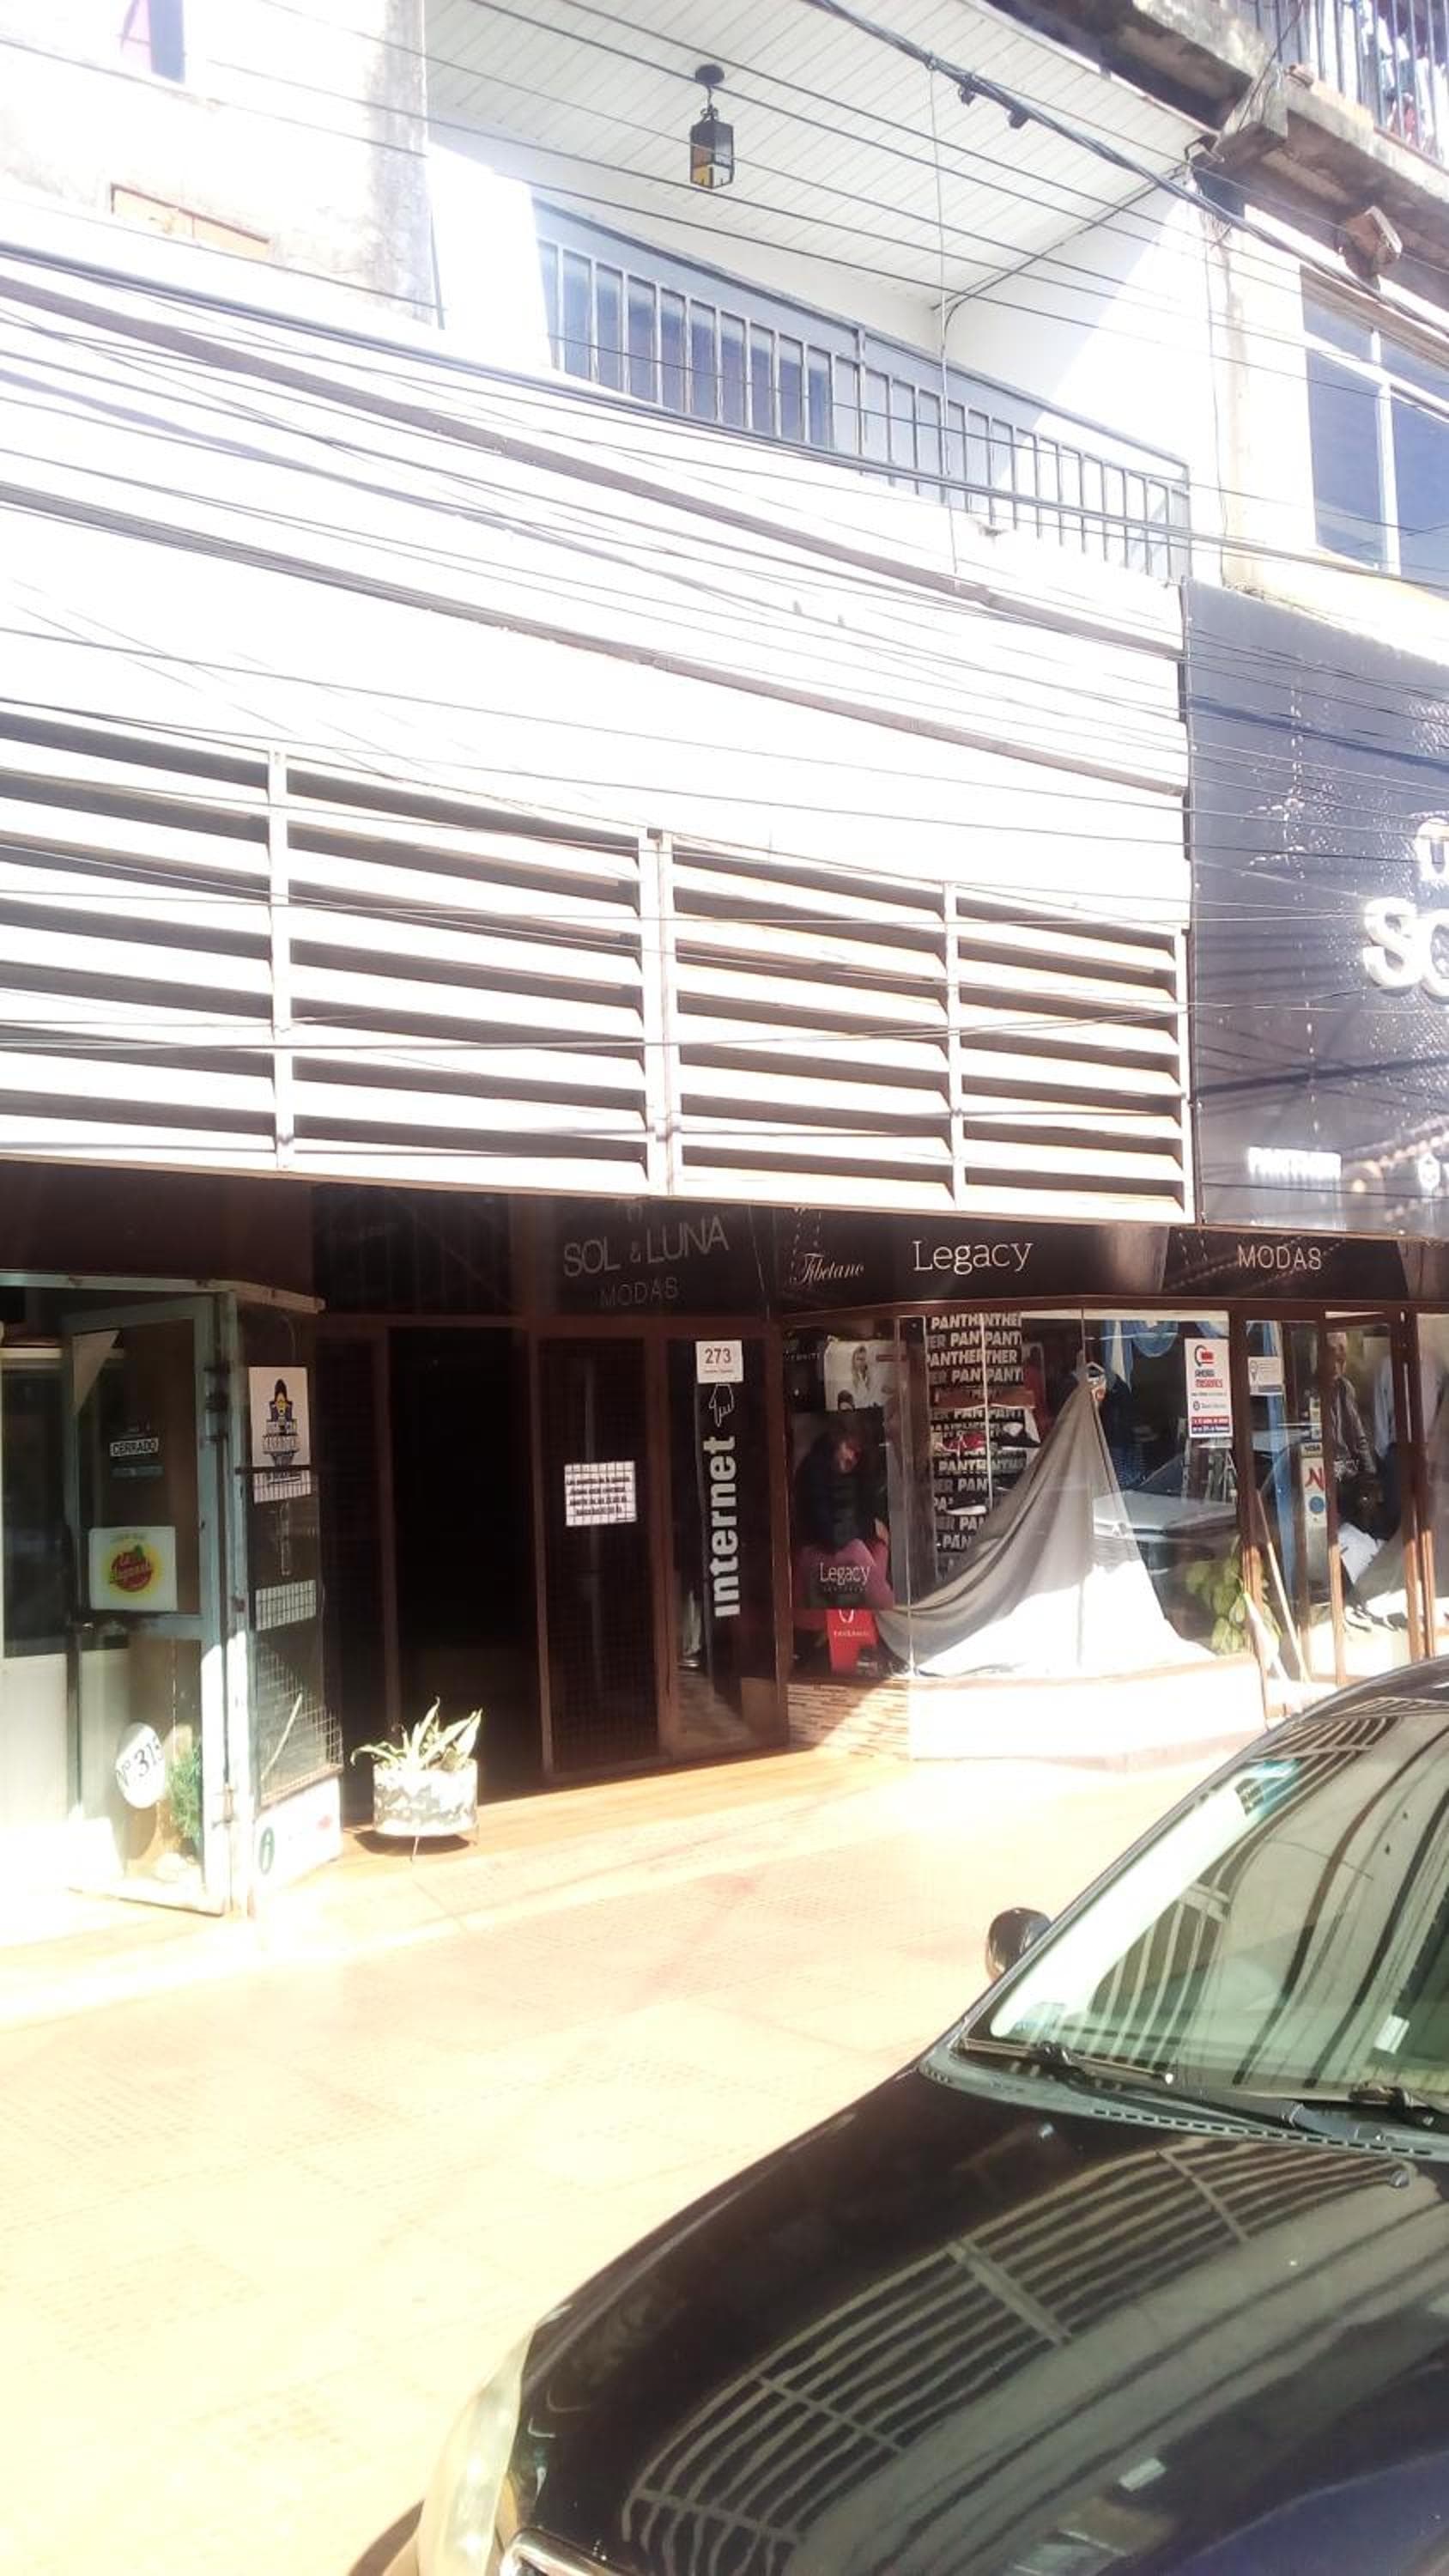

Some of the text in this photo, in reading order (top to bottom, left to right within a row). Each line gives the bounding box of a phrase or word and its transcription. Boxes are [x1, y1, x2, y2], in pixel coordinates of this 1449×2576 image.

[563, 1236, 621, 1277] SOL
[647, 1215, 730, 1264] LUNA
[912, 1240, 1034, 1275] Legacy
[1238, 1245, 1322, 1270] MODAS
[603, 1277, 680, 1305] MODAS
[705, 1347, 731, 1364] 273
[113, 1443, 156, 1455] CERRADO
[703, 1435, 741, 1618] Internet
[820, 1562, 870, 1586] Legacy
